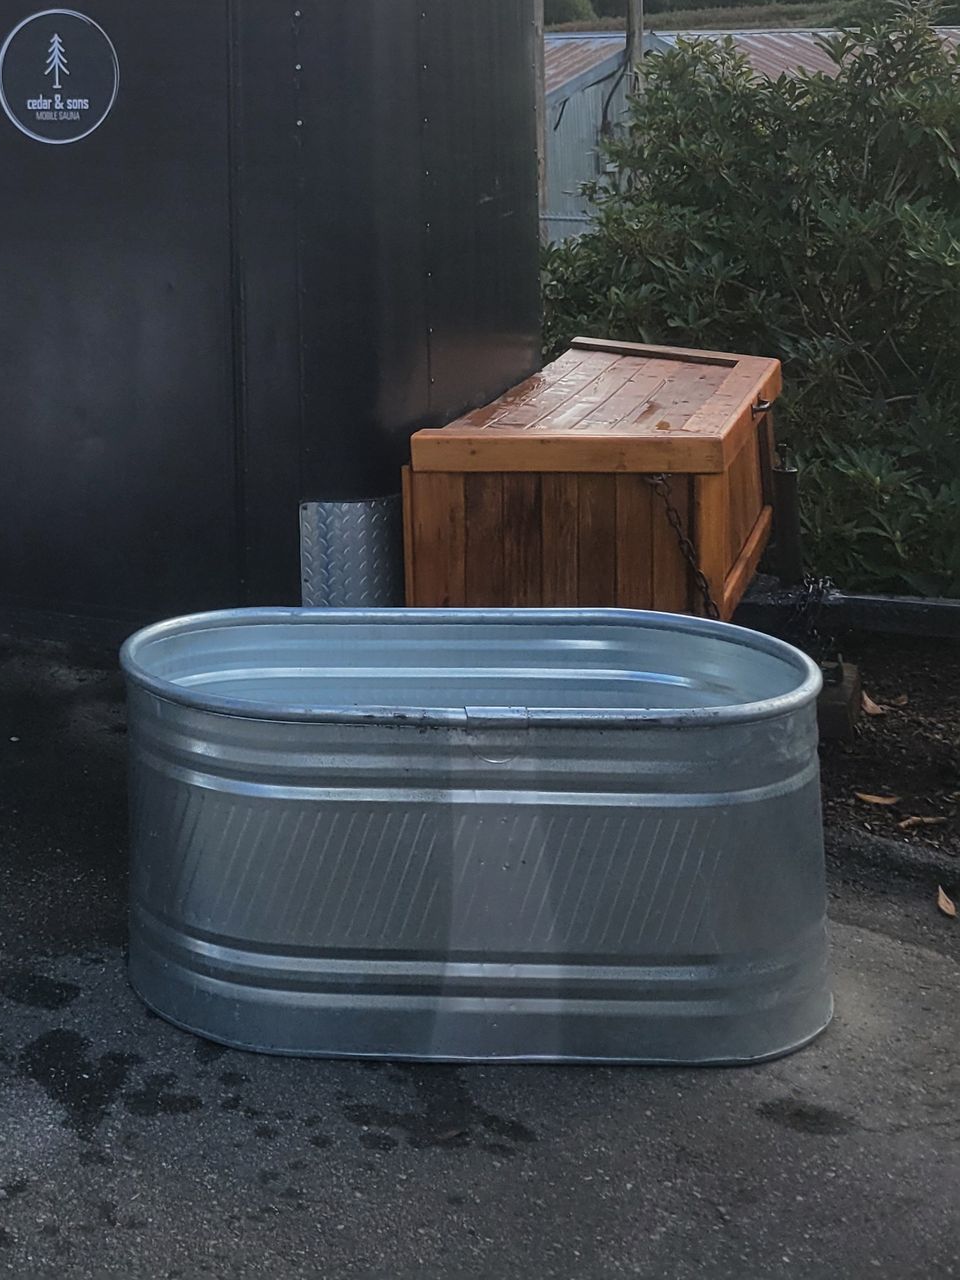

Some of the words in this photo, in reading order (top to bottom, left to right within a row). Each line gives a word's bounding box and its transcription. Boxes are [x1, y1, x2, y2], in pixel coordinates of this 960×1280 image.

[27, 94, 52, 110] cedar
[54, 94, 64, 110] &
[67, 99, 89, 110] sons
[36, 111, 57, 120] MOBILE
[58, 111, 80, 120] SAUNA
